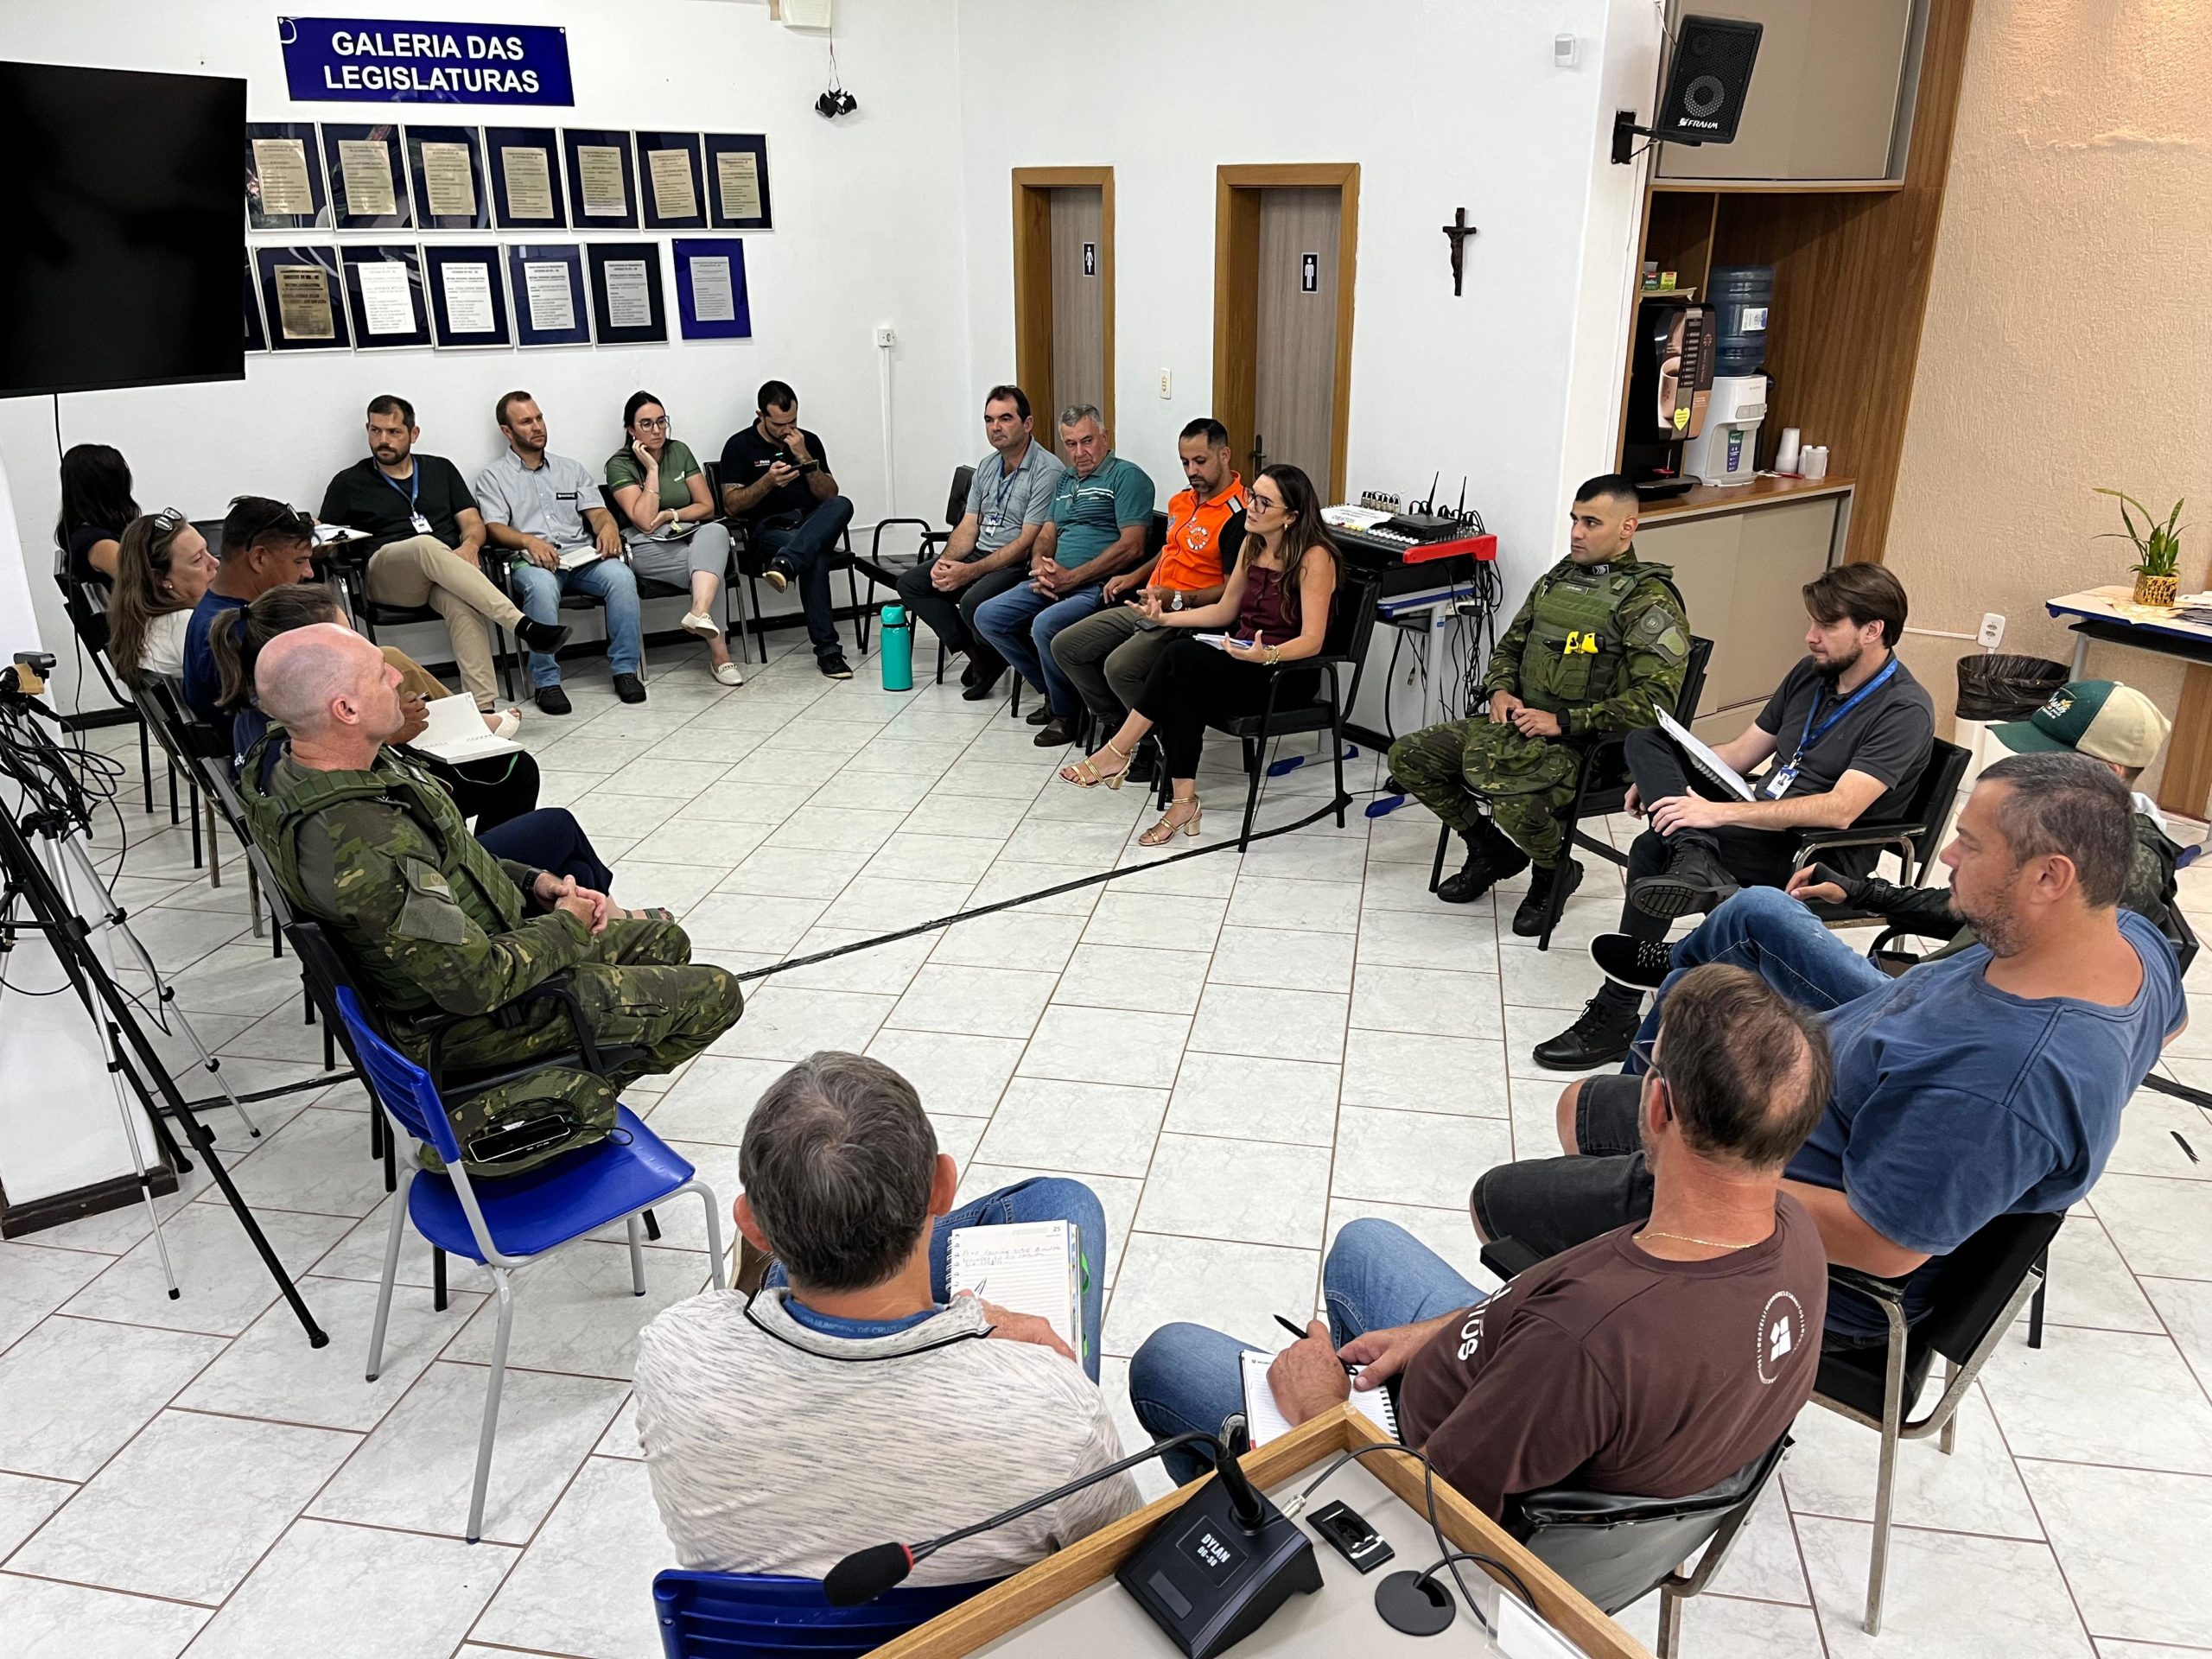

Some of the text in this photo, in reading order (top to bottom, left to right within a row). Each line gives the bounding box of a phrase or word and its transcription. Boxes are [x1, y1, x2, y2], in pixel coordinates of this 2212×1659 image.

[332, 31, 524, 60] GALERIA DAS
[324, 65, 539, 93] LEGISLATURAS
[1688, 119, 1719, 130] FRAHM
[1201, 1533, 1230, 1563] DYLAN
